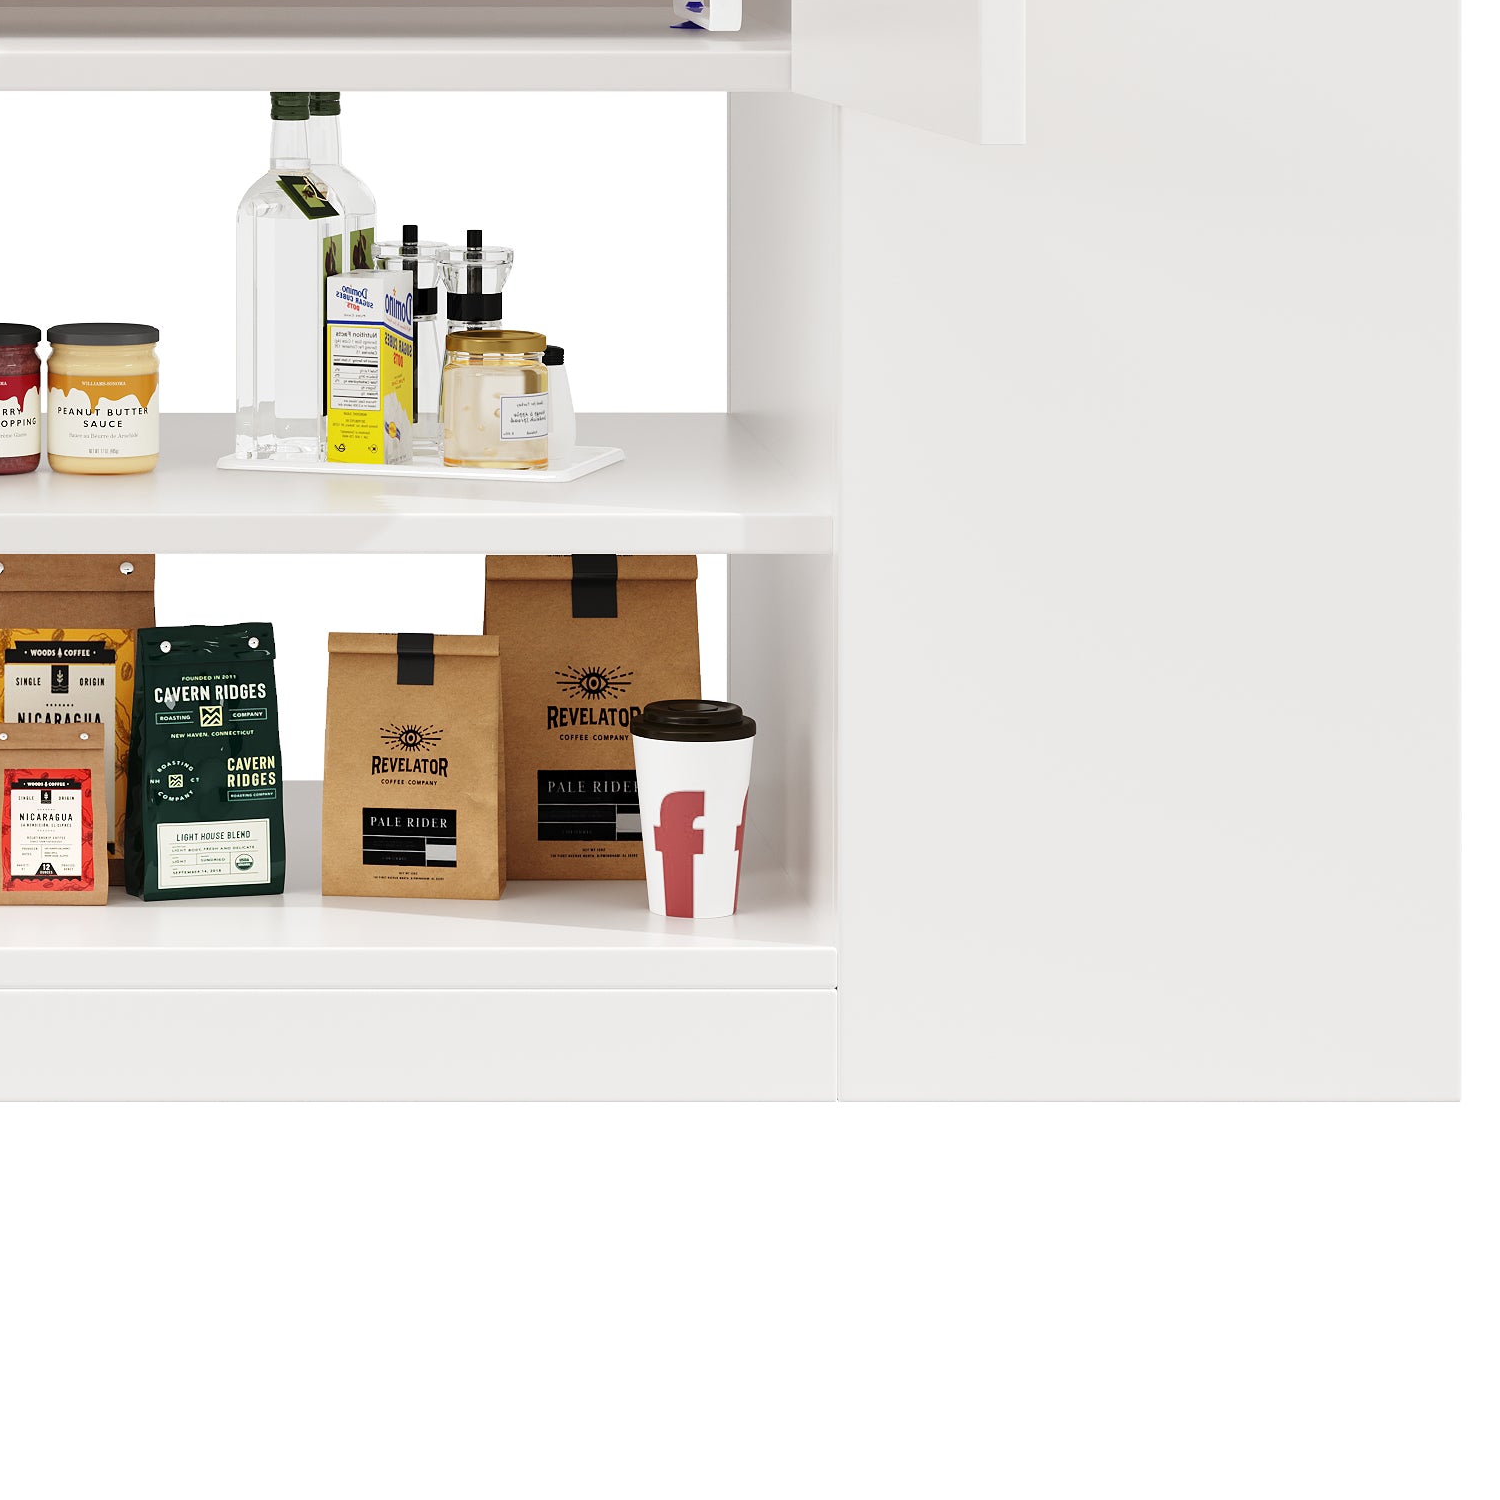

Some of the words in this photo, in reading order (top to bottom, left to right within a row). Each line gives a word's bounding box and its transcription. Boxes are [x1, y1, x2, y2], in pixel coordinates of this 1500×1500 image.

[58, 407, 100, 416] PEANUT
[108, 407, 148, 416] BUTTER
[16, 678, 41, 686] SINGLE
[79, 678, 105, 686] ORIGIN
[154, 685, 210, 703] CAVERN
[215, 683, 267, 700] RIDGES
[18, 712, 101, 724] NICARAGUA
[157, 760, 194, 773] ROASTING
[228, 756, 275, 771] CAVERN
[372, 756, 448, 777] REVELATOR
[228, 772, 276, 788] RIDGES
[548, 781, 586, 792] PALE
[157, 790, 194, 802] COMPANY
[19, 813, 73, 821] NICARAGUA
[370, 816, 402, 827] PALE
[407, 818, 447, 828] RIDER
[177, 833, 198, 842] LIGHT
[201, 832, 224, 841] HOUSE
[228, 831, 251, 839] BLEND
